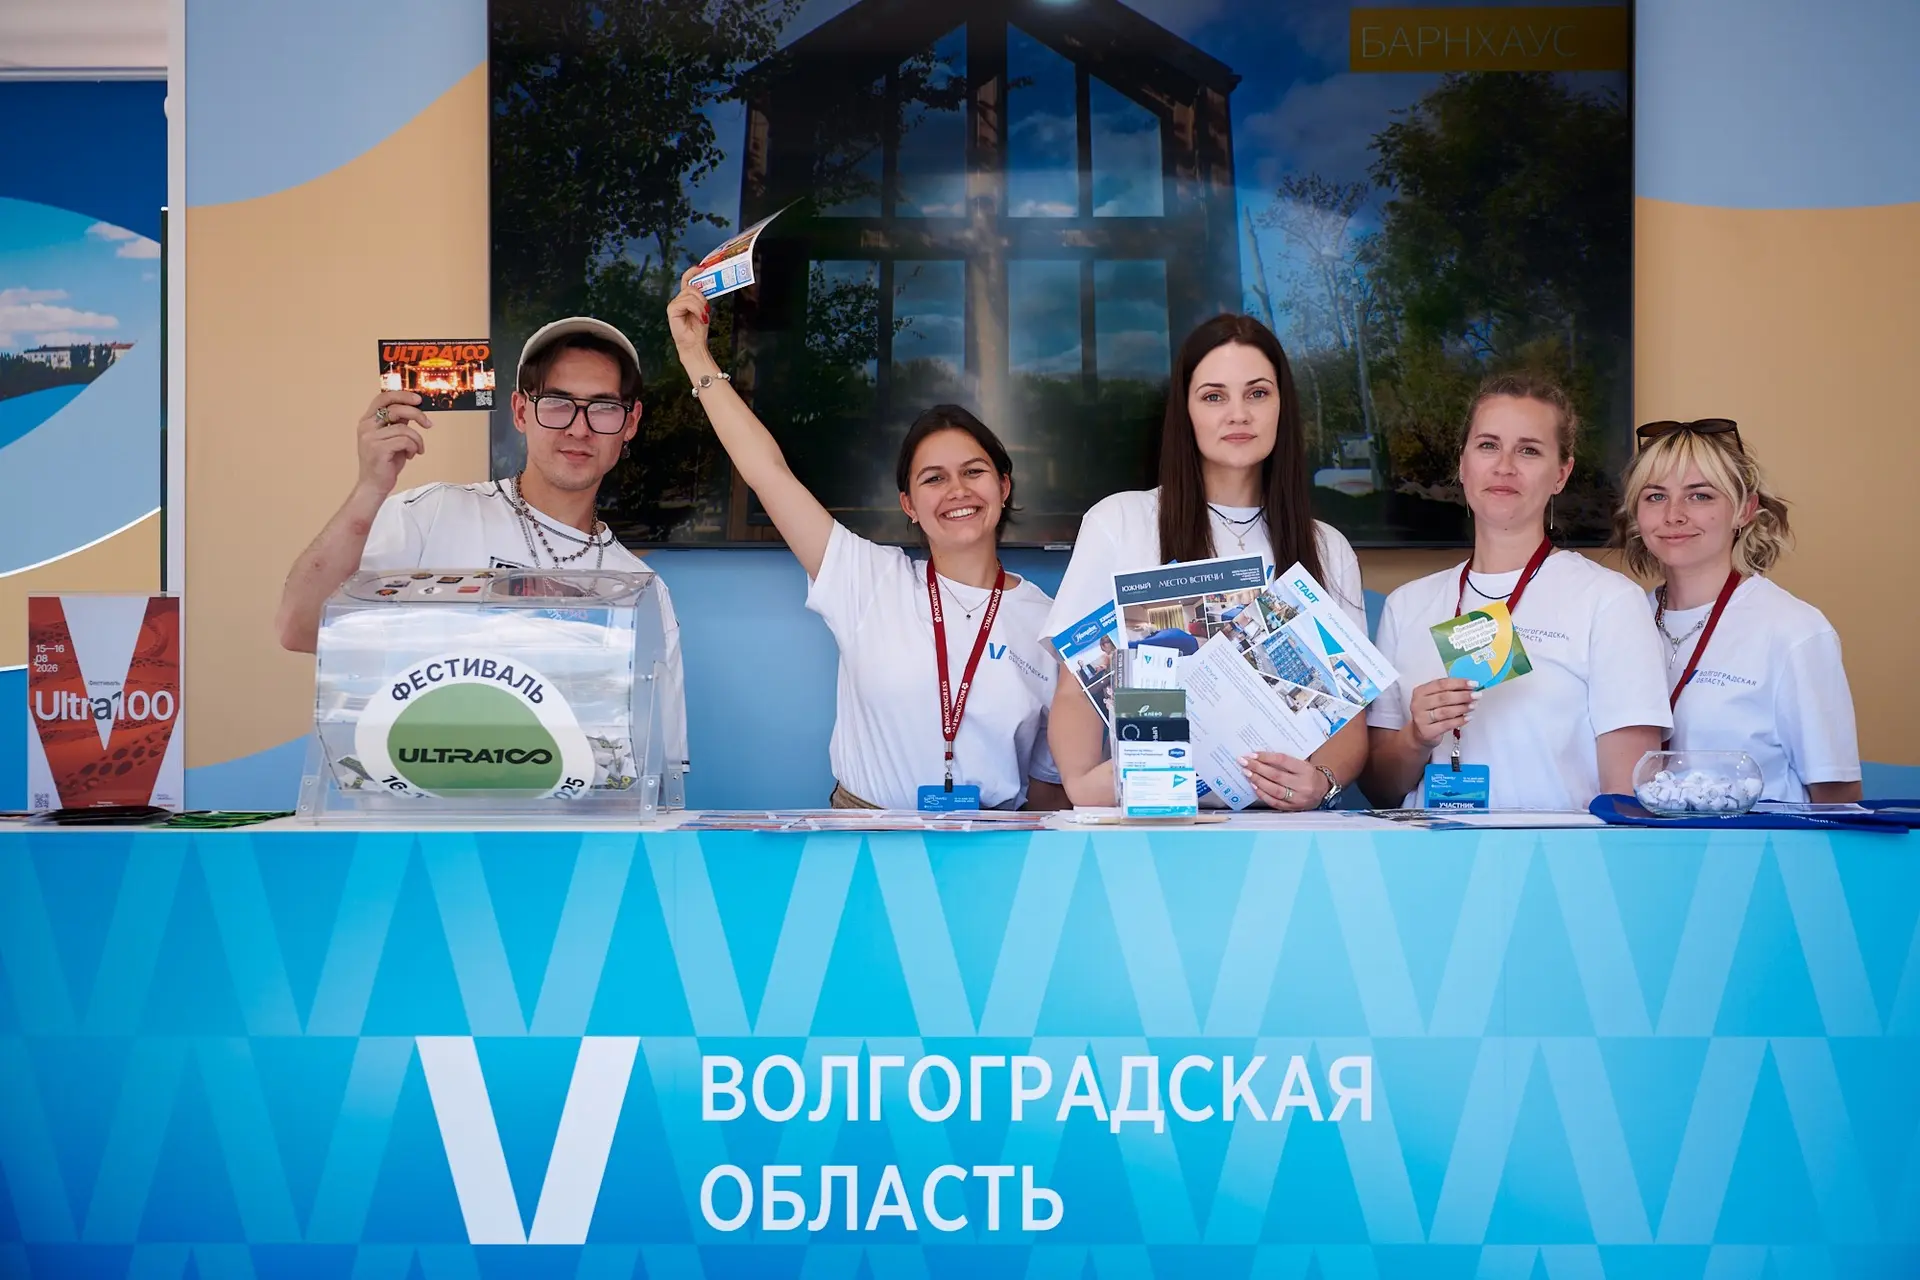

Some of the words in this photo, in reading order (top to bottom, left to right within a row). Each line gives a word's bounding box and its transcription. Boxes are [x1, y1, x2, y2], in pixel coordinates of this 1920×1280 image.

[1361, 25, 1578, 59] БАРНХАУС
[1121, 581, 1151, 593] ЮЖНЫЙ
[1158, 577, 1188, 588] МЕСТО
[1189, 572, 1225, 584] ВСТРЕЧИ
[1293, 578, 1320, 604] СТАРТ
[35, 654, 48, 663] 08
[36, 664, 58, 673] 2026
[391, 656, 544, 705] ФЕСТИВАЛЬ
[1699, 670, 1757, 686] ВОЛГОГРАДСКАЯ
[35, 690, 174, 720] Ultra100
[701, 1054, 1373, 1133] ВОЛГОГРАДСКАЯ
[699, 1165, 1064, 1232] ОБЛАСТЬ
